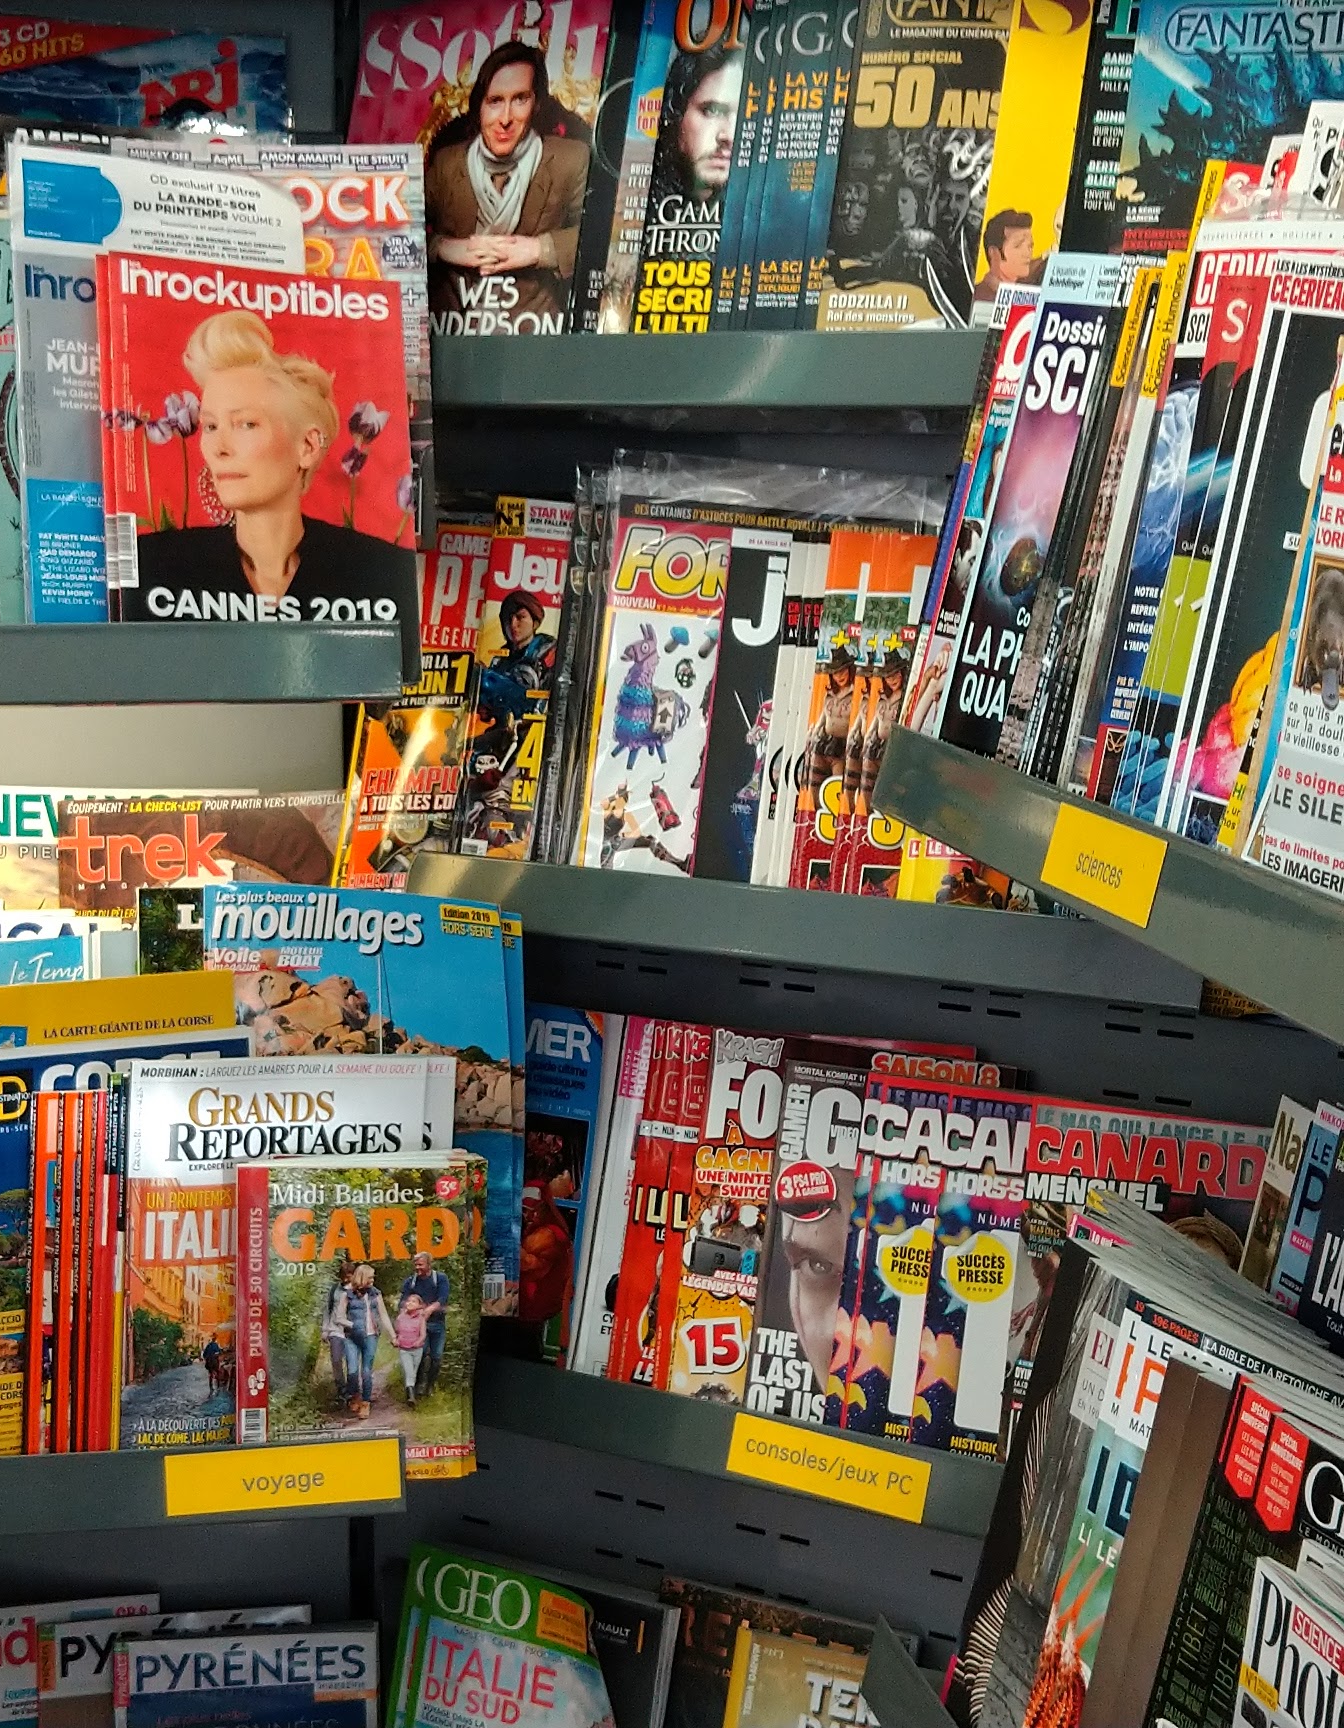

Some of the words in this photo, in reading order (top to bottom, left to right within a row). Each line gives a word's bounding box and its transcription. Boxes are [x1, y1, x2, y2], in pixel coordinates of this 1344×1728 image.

[16, 22, 50, 43] CD
[0, 46, 24, 66] 60
[31, 35, 85, 58] HITS
[854, 66, 933, 129] 50
[155, 203, 228, 220] PRINTEMPS
[179, 194, 256, 212] BANDE-SON
[643, 261, 712, 287] TOUS
[459, 275, 519, 308] WES
[147, 587, 298, 621] CANNES
[58, 813, 228, 884] trek
[1261, 848, 1281, 872] LES
[1293, 841, 1329, 864] limites
[1075, 850, 1123, 889] sciences
[212, 894, 423, 954] mouillages
[187, 1087, 336, 1127] GRANDS
[172, 1190, 232, 1207] PRINTEMPS
[272, 1182, 326, 1207] Midi
[335, 1182, 425, 1204] Balades
[271, 1207, 460, 1262] GARD
[957, 1267, 1004, 1284] PRESSE
[756, 1328, 798, 1357] THE
[751, 1354, 813, 1386] LAST
[1278, 1368, 1329, 1403] RETOUCHE
[242, 1468, 325, 1494] voyage
[745, 1436, 880, 1487] consoles/jeux
[886, 1472, 911, 1495] PC
[433, 1562, 532, 1629] GEO
[1293, 1608, 1344, 1658] SCIENCE
[135, 1644, 366, 1693] PYRÉNÉES
[429, 1645, 557, 1709] ITALIE
[425, 1673, 458, 1705] DU
[466, 1688, 521, 1724] SUD
